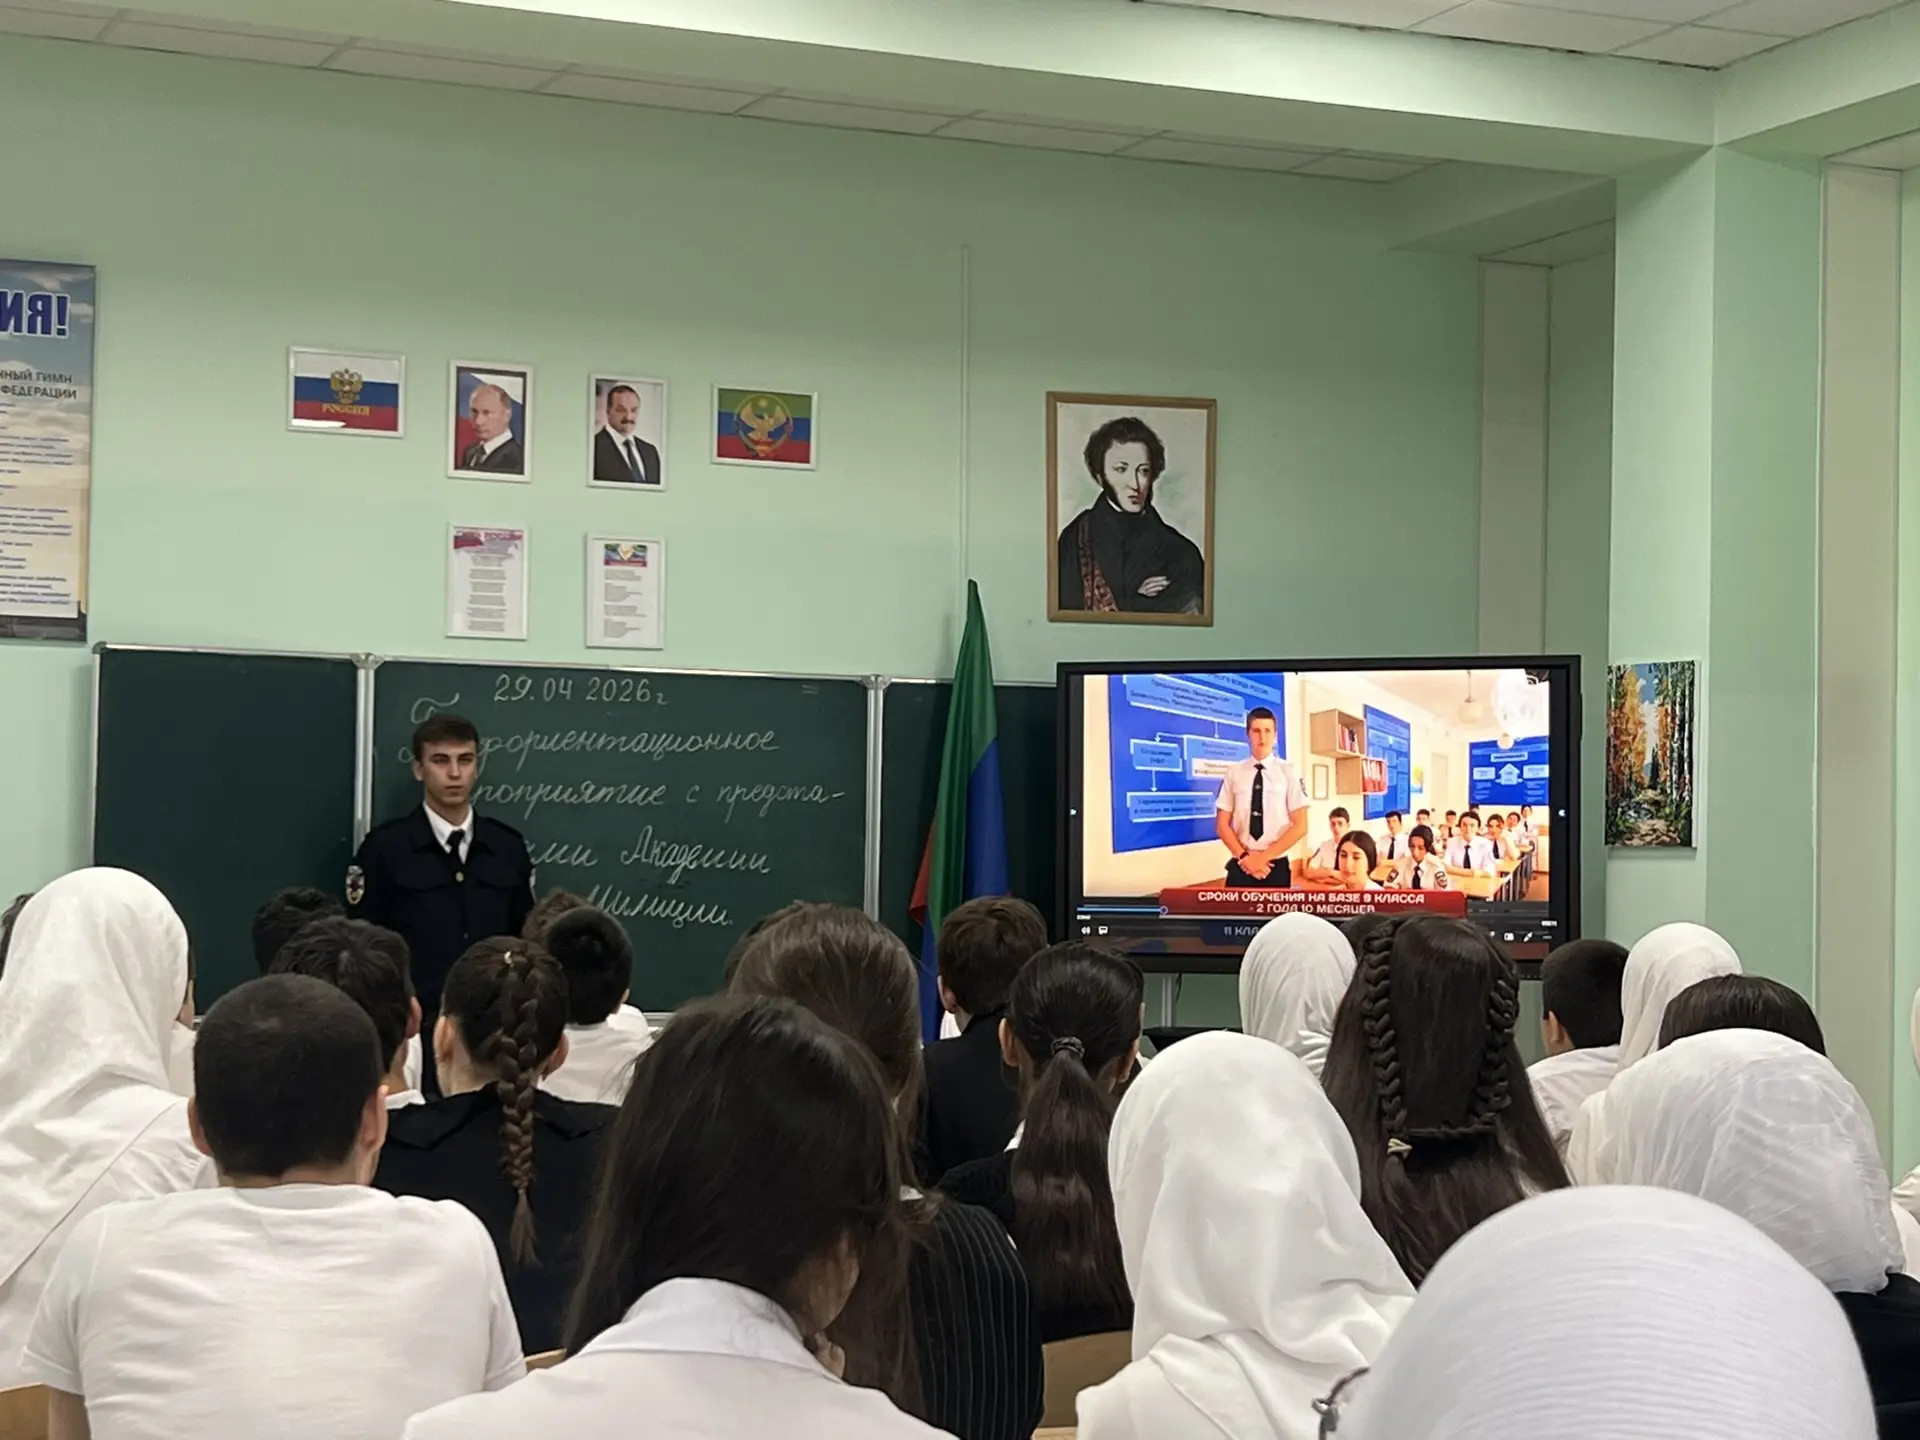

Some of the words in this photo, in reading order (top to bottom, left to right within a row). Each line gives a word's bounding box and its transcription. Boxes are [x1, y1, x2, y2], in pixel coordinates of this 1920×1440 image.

[36, 371, 73, 383] ГИМН
[1, 384, 77, 399] ФЕДЕРАЦИИ
[620, 824, 771, 885] Академии
[1197, 890, 1239, 902] СРОКИ
[1241, 890, 1305, 903] ОБУЧЕНИЯ
[1307, 891, 1326, 903] НА
[1328, 892, 1360, 904] БАЗЕ
[1374, 892, 1425, 905] КЛАССА
[1256, 903, 1265, 913] 2
[1316, 903, 1376, 914] МЕСЯЦЕВ
